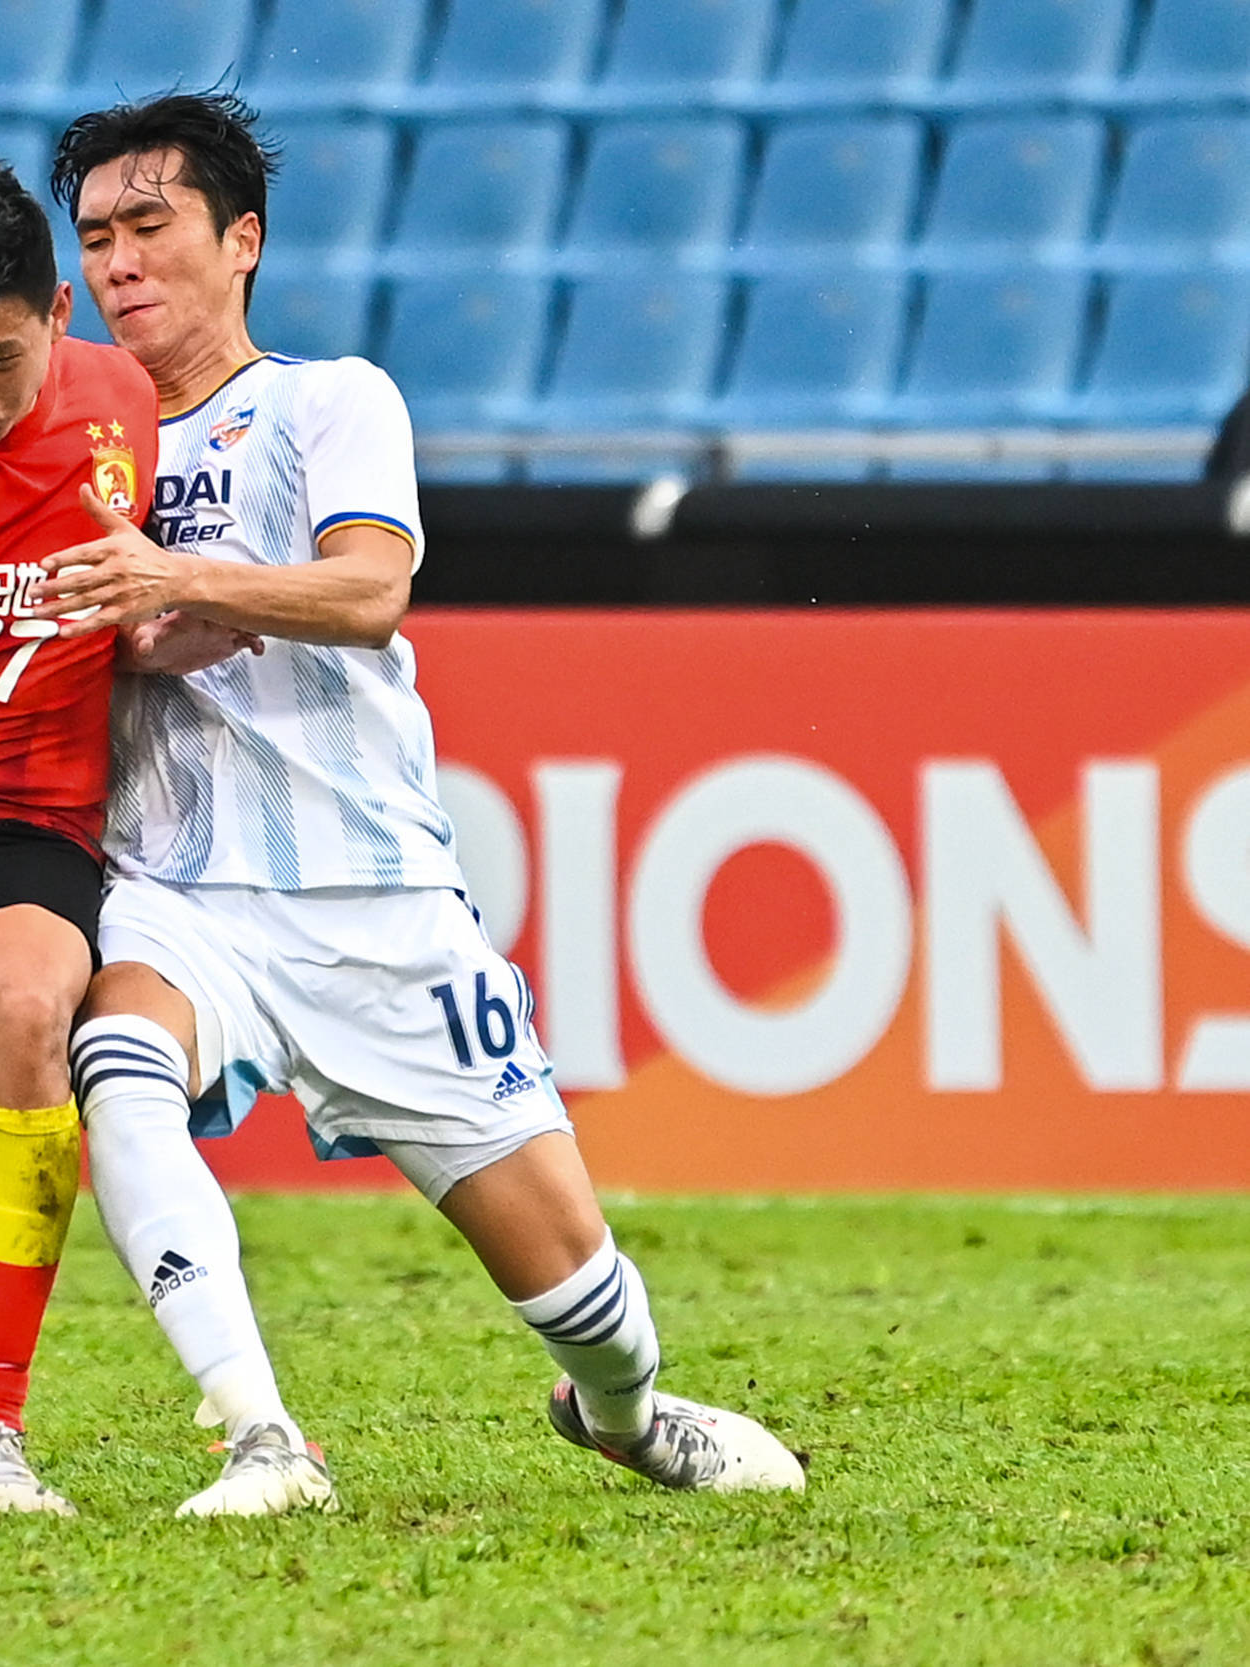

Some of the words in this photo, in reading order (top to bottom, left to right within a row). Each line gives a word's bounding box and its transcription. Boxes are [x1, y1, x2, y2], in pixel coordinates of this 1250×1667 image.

[153, 469, 232, 511] DAI
[428, 969, 517, 1071] 16
[493, 1079, 536, 1101] adidas
[150, 1266, 208, 1309] adidas
